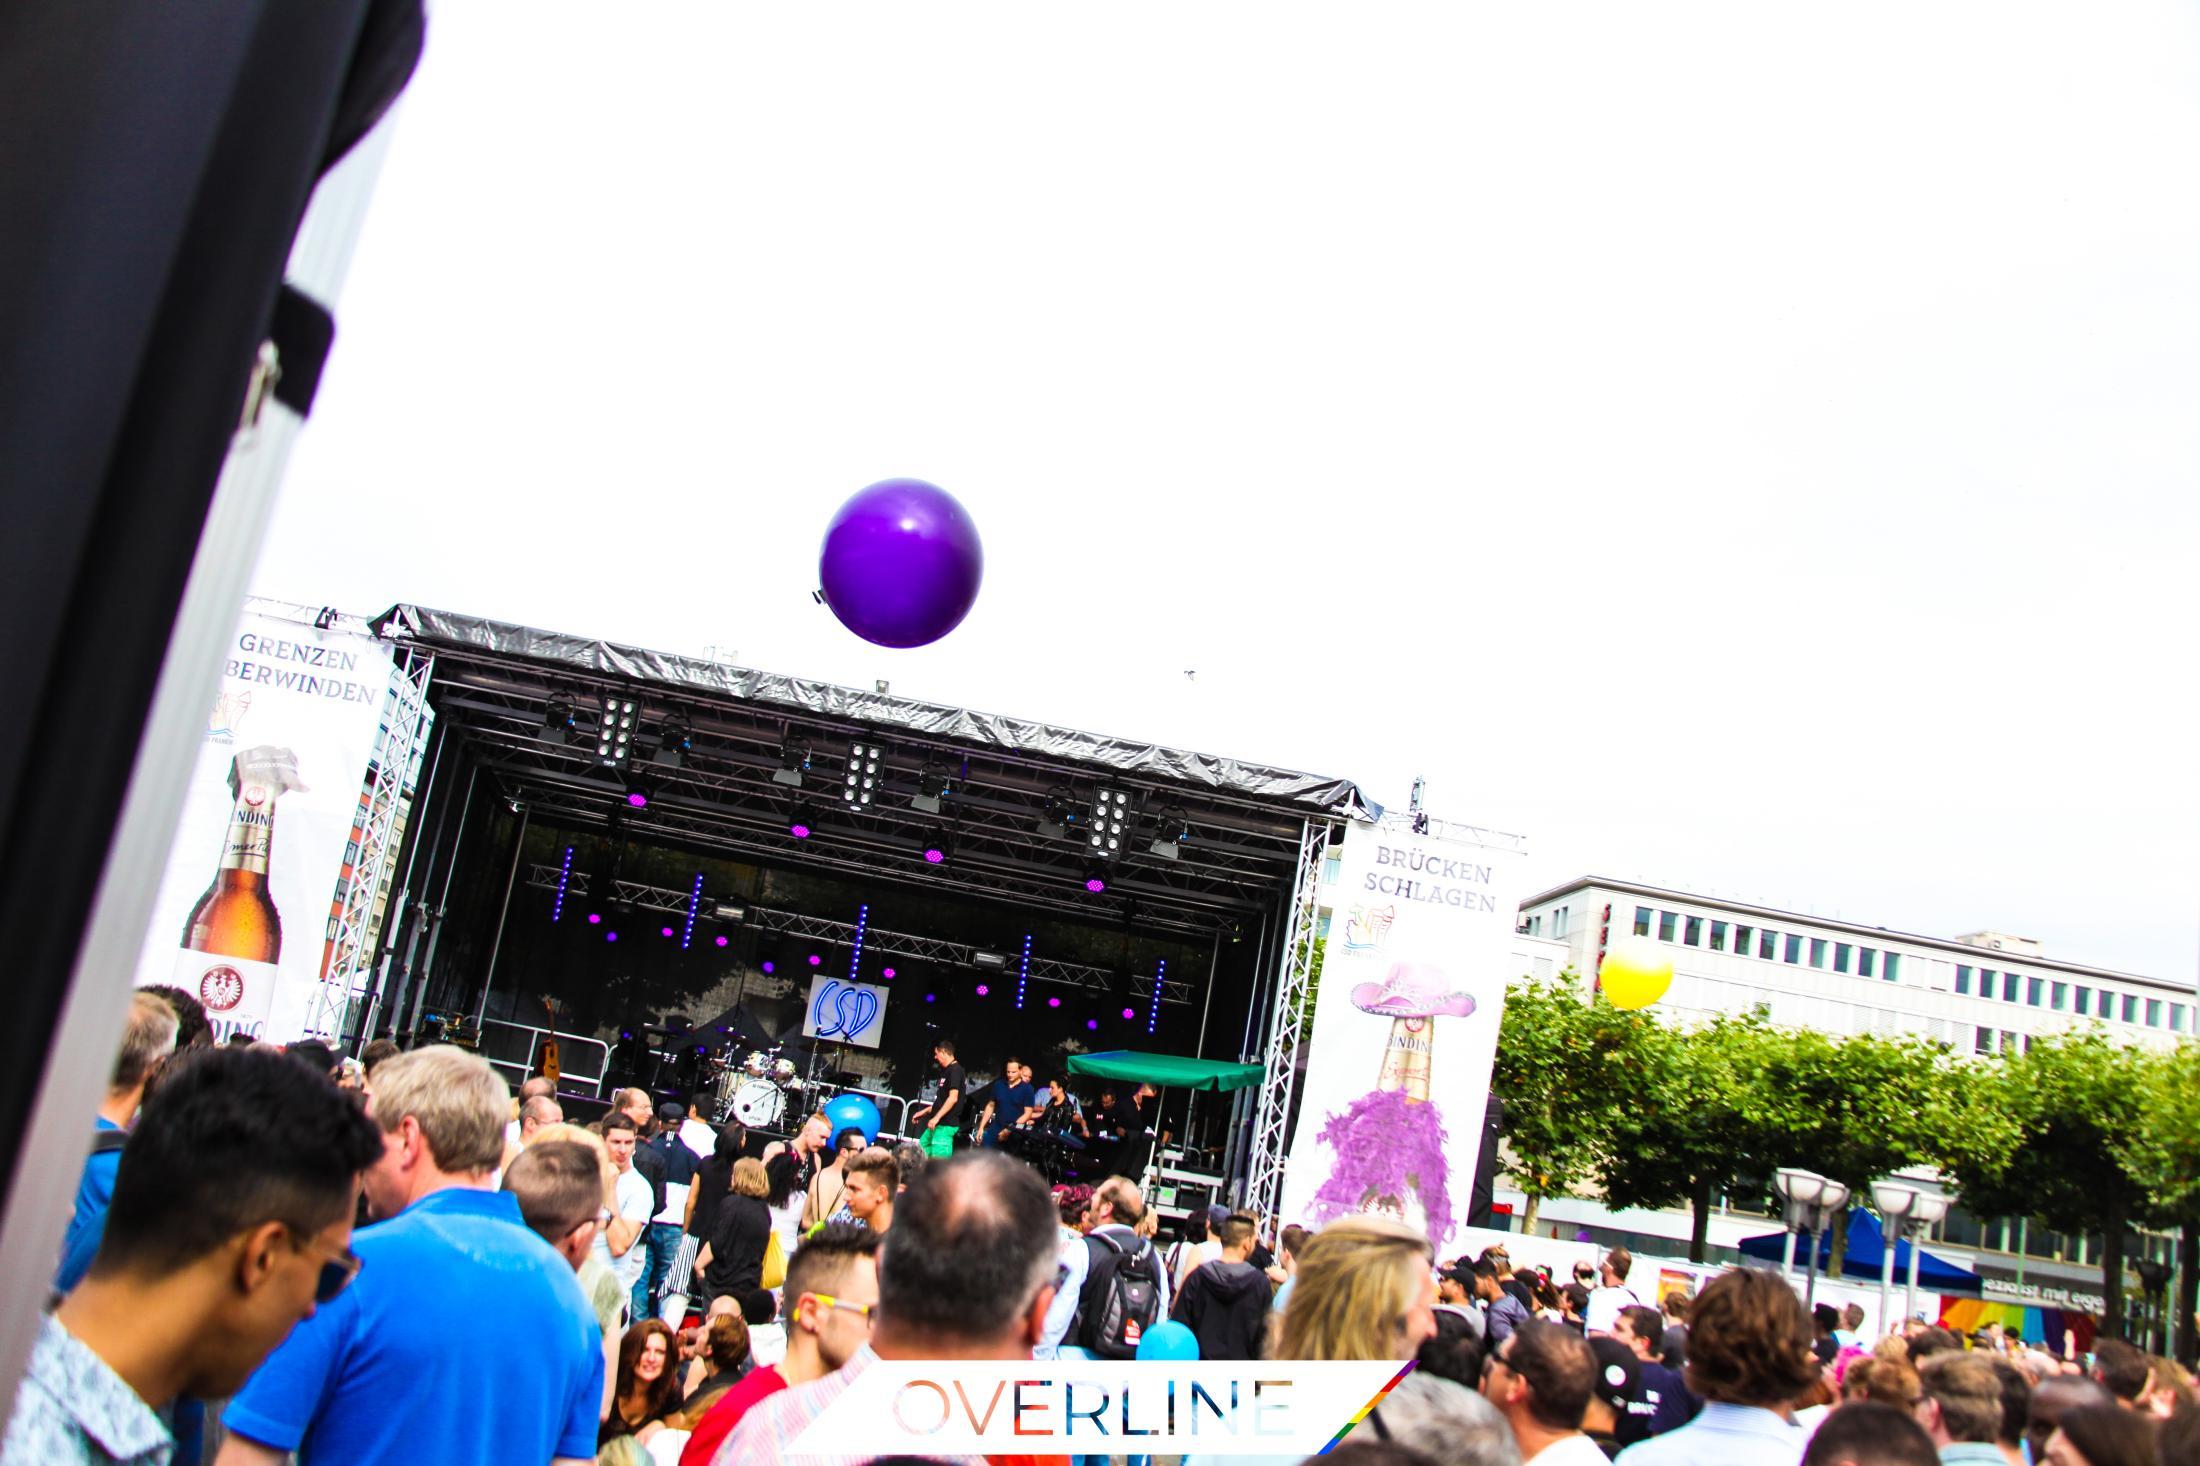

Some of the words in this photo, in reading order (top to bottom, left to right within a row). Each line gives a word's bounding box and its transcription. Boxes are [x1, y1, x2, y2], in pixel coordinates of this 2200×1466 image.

[239, 632, 358, 672] GRENZEN
[1376, 845, 1492, 885] BRÜCKEN
[1364, 872, 1496, 912] SCHLAGEN
[814, 980, 878, 1038] CSD
